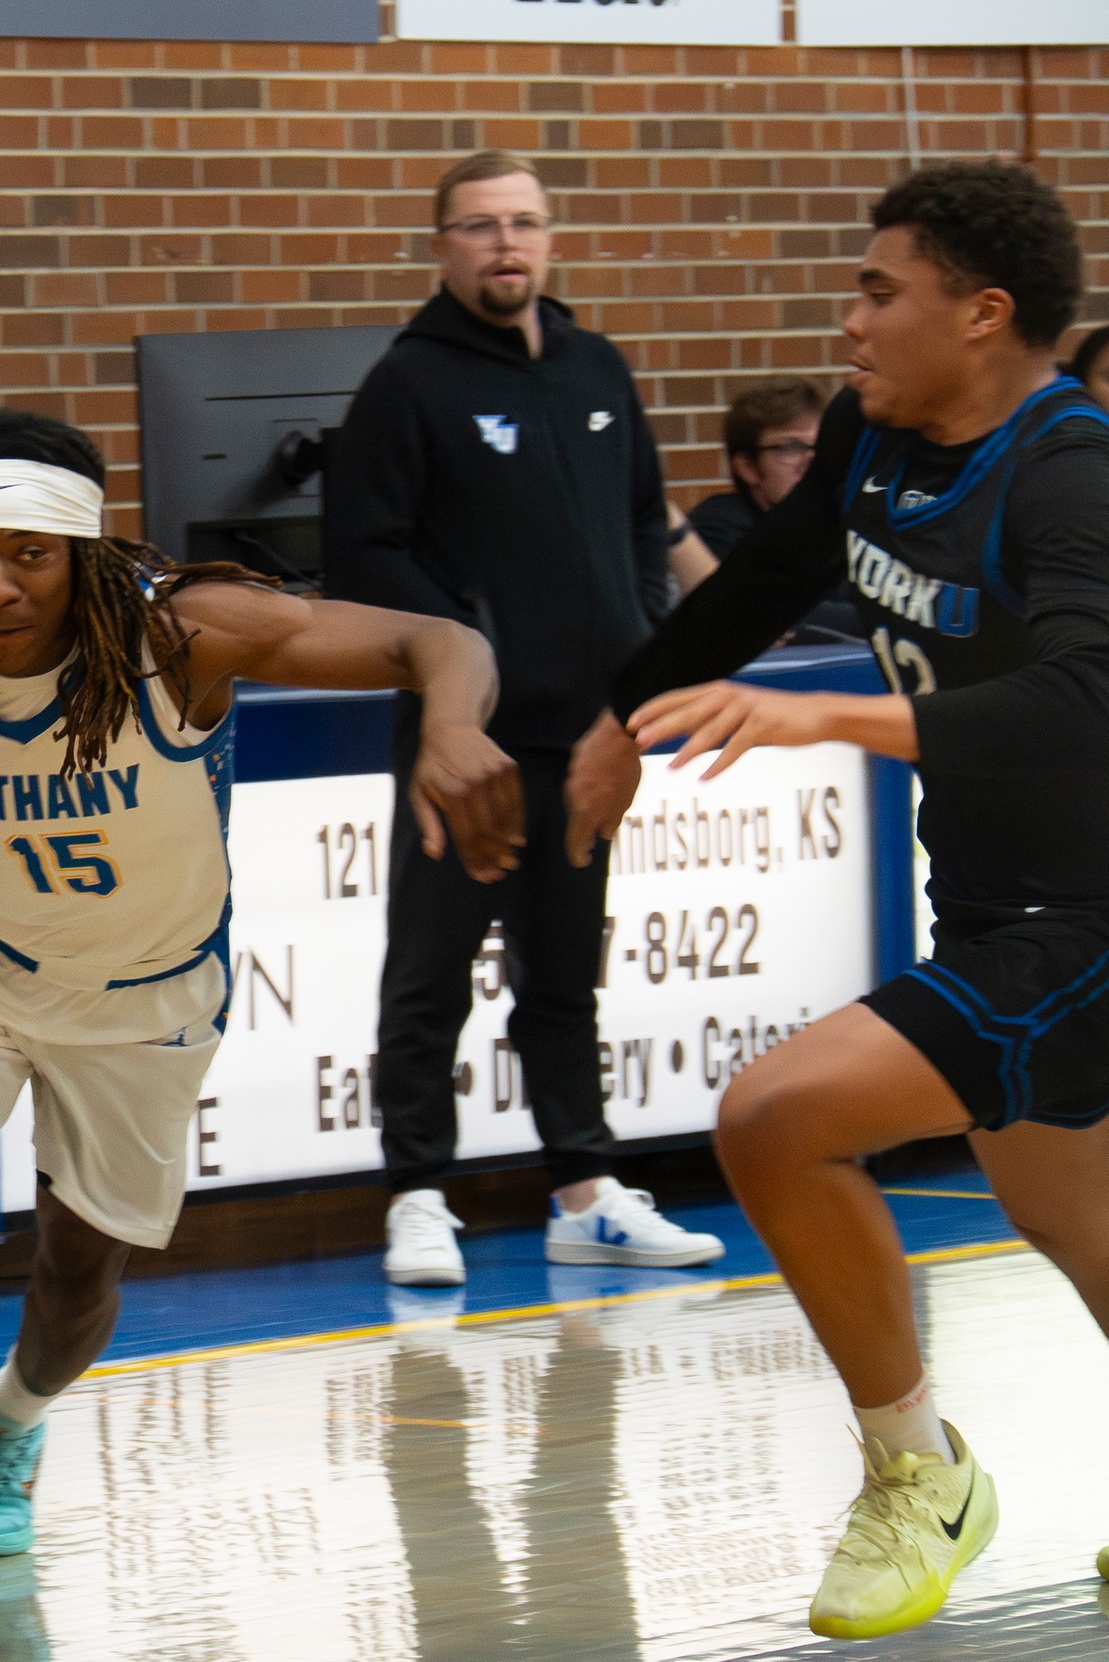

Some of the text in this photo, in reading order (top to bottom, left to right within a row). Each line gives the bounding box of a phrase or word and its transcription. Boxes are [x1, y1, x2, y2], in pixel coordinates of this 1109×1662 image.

[4, 829, 124, 899] 15
[316, 821, 378, 899] 121
[796, 785, 844, 861] KS
